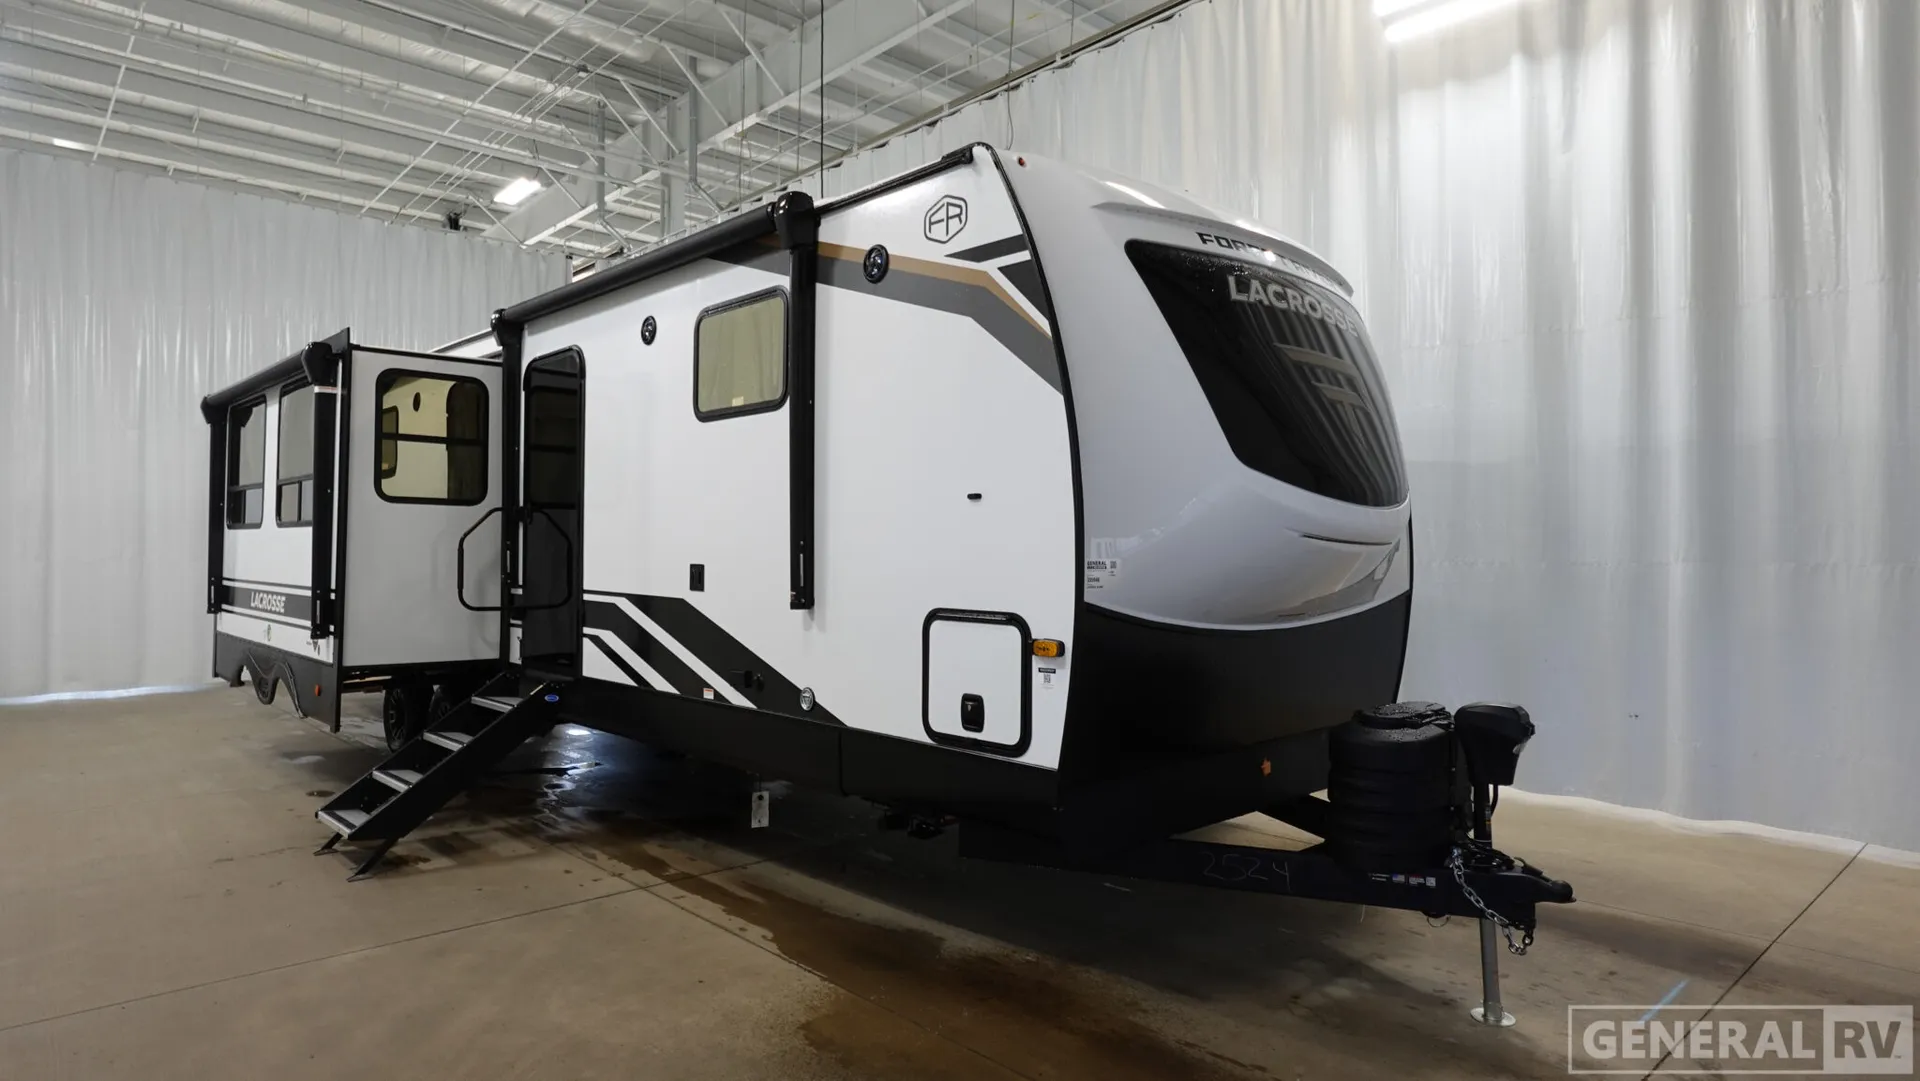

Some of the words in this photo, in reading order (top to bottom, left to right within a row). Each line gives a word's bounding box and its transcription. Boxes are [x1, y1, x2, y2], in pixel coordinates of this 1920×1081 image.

[1227, 274, 1360, 338] LACROSSE
[250, 591, 287, 613] LACROSSE
[1201, 853, 1291, 892] 2524
